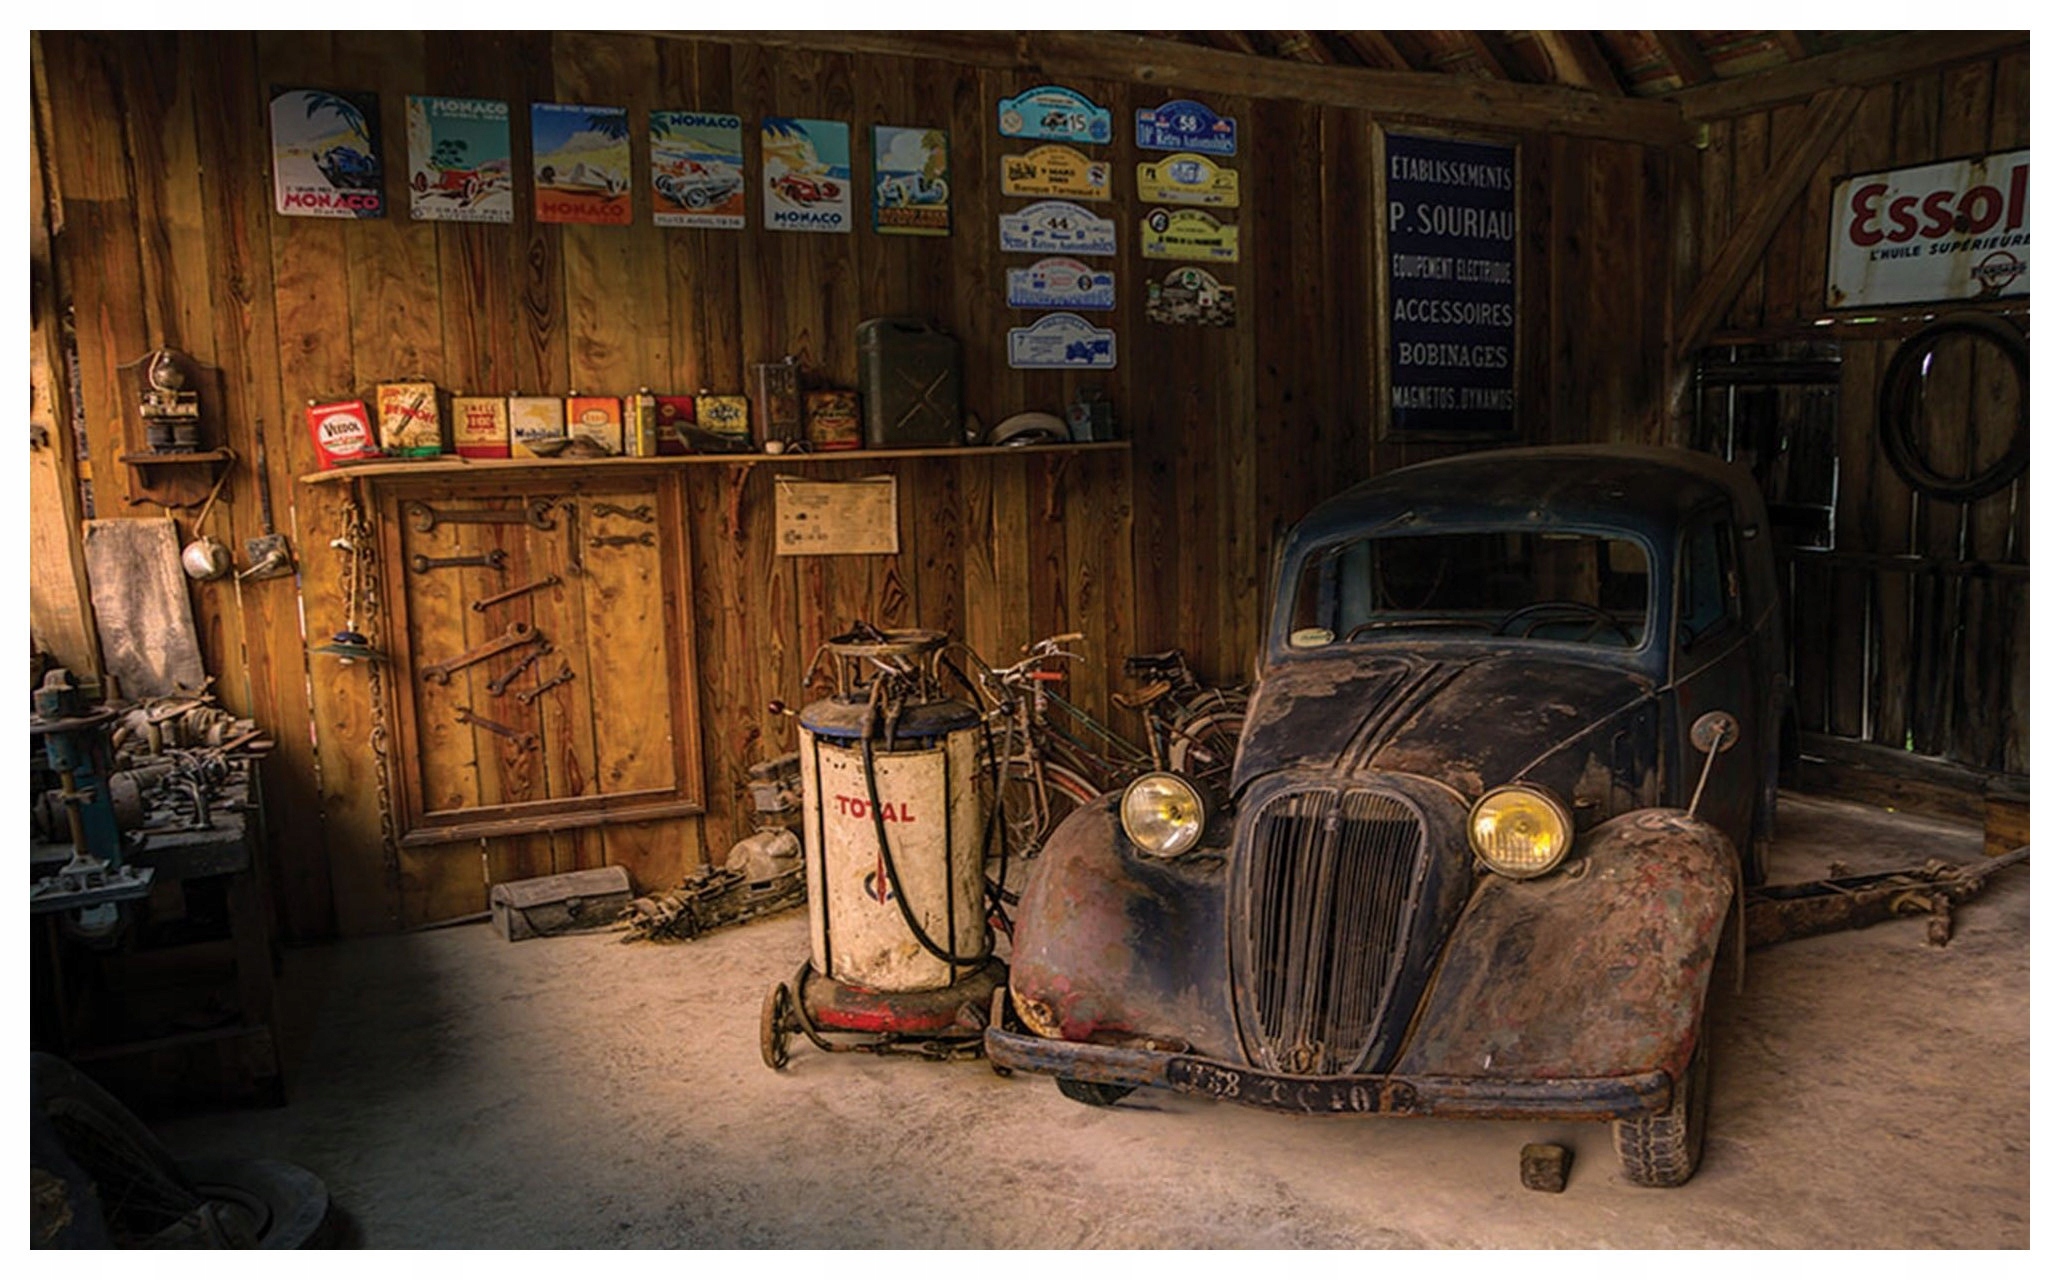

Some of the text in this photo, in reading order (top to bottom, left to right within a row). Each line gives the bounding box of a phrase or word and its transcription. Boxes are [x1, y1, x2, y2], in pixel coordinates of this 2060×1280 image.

[433, 99, 509, 114] MONACO
[670, 114, 739, 129] MONACO
[1069, 114, 1086, 131] 15
[285, 193, 380, 210] MONACO
[543, 202, 624, 216] MONACO
[774, 211, 842, 224] MONACO
[1048, 217, 1069, 229] 44
[1870, 245, 1921, 261] L'HUILE
[1393, 297, 1513, 327] ACCESSOIRES
[1397, 341, 1510, 369] BOBINAGES
